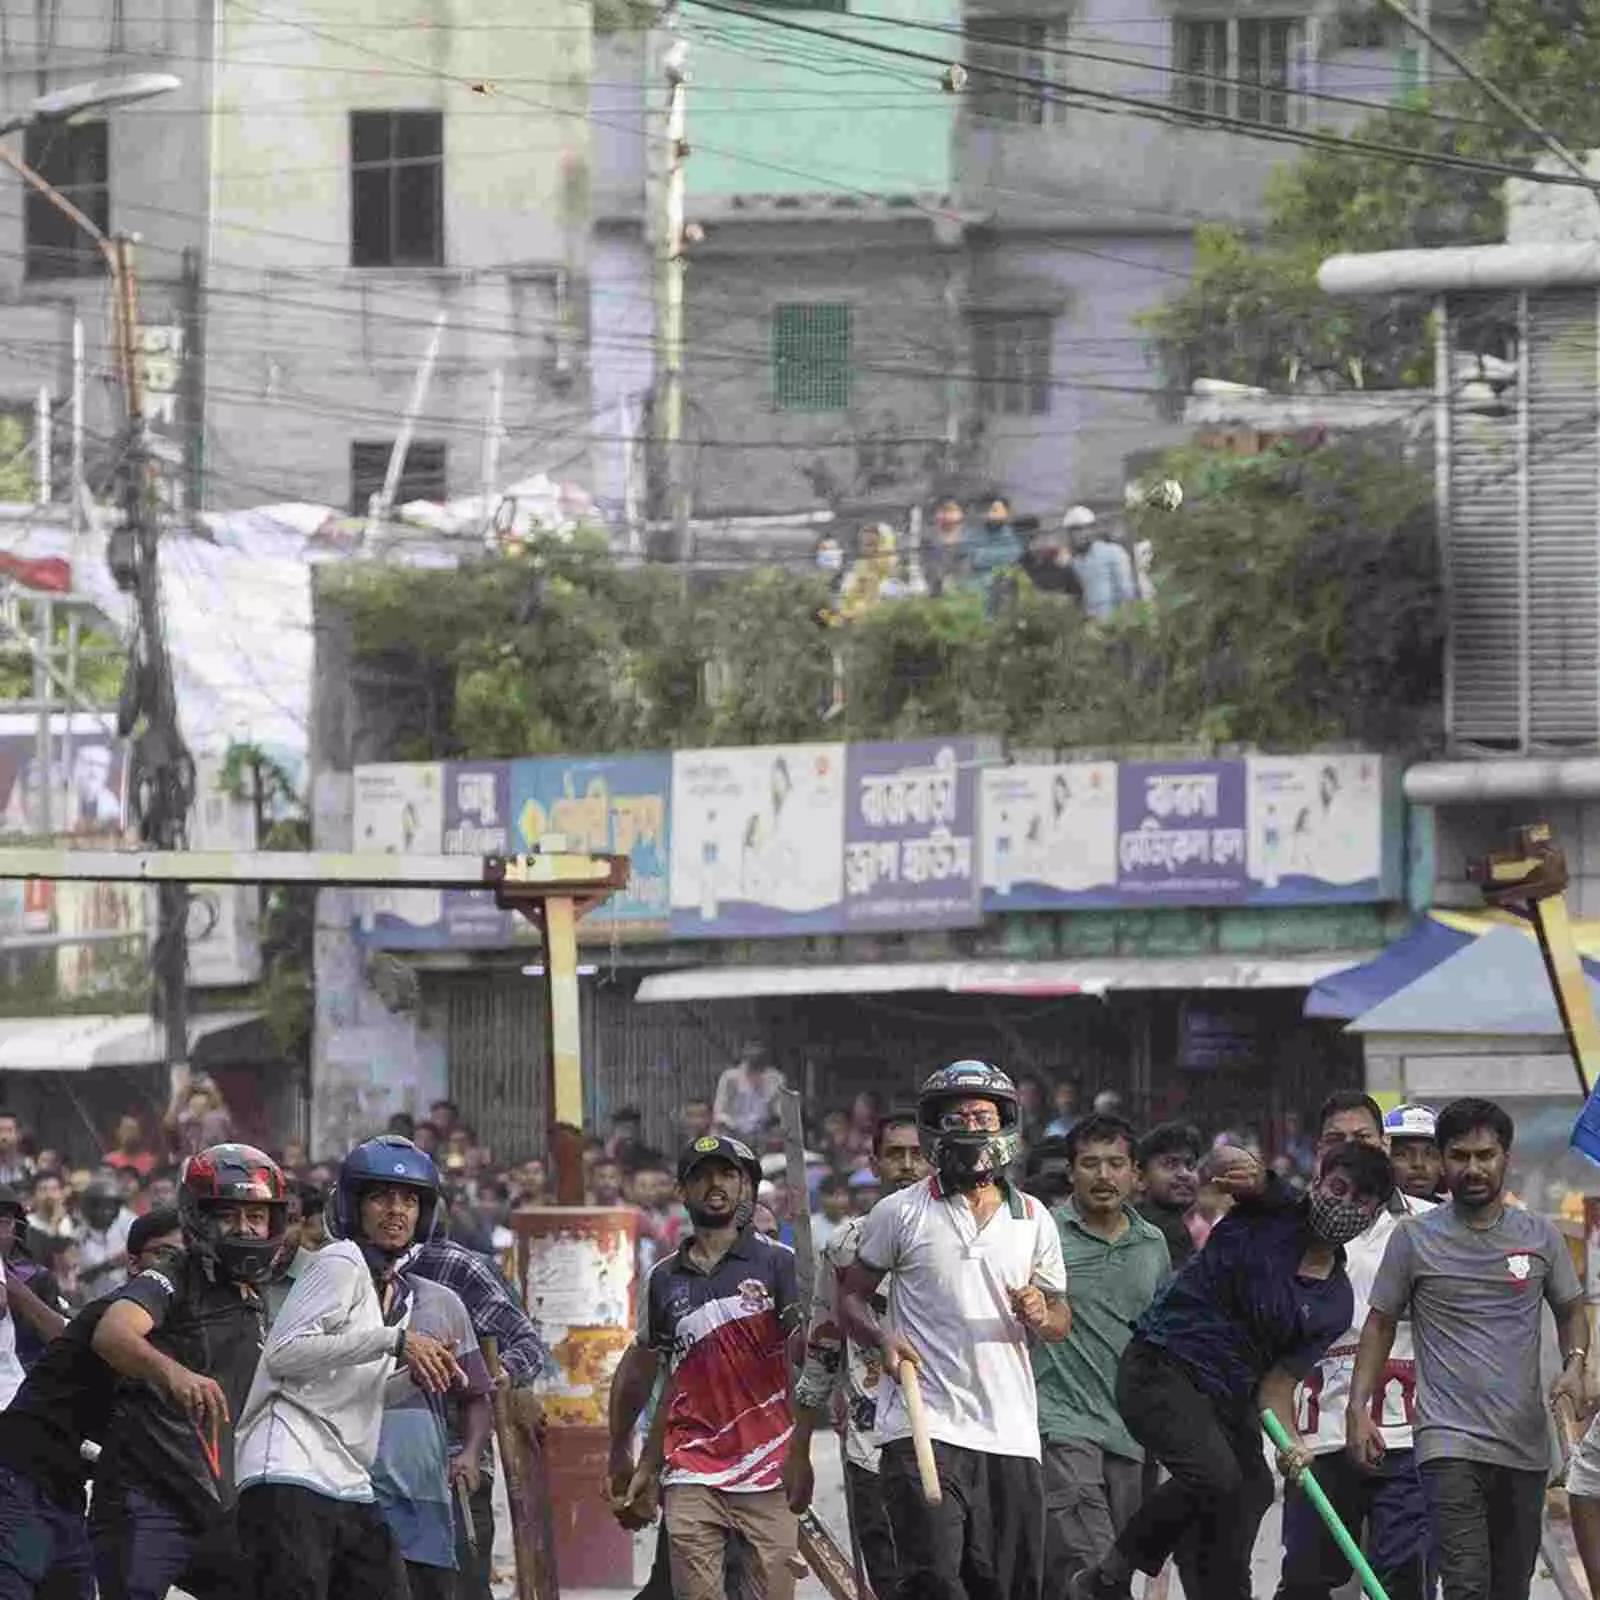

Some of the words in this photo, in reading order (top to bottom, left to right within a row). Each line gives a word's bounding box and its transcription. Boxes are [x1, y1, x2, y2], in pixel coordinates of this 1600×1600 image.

[901, 828, 971, 882] হাউস
[1120, 816, 1209, 872] মেডিকেল
[1212, 828, 1243, 864] হল
